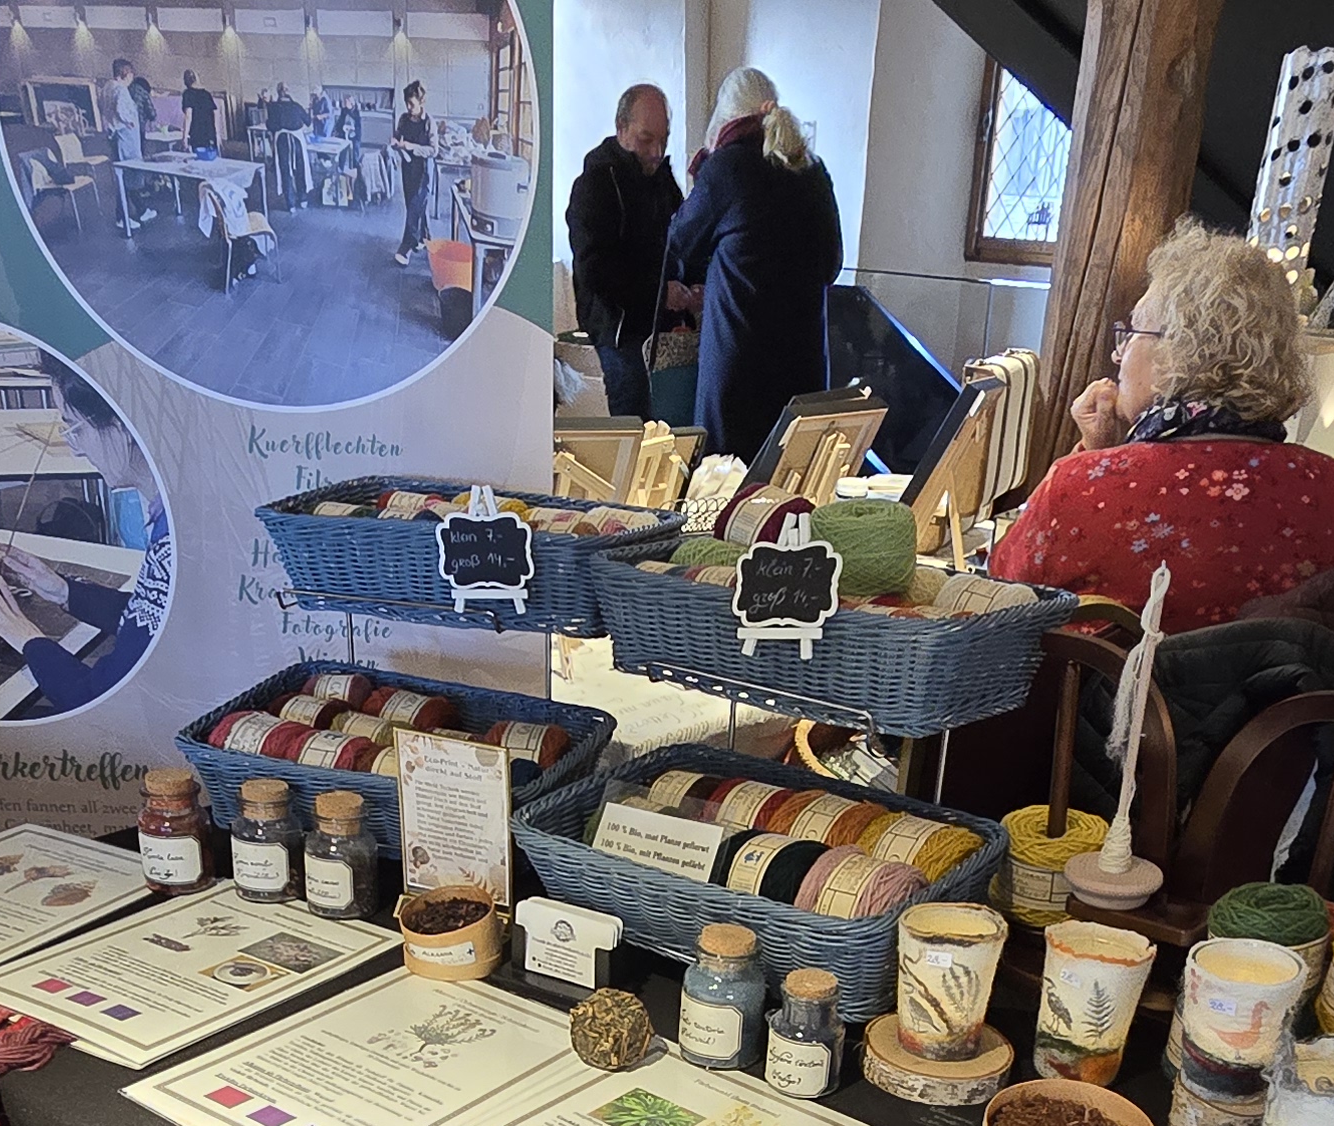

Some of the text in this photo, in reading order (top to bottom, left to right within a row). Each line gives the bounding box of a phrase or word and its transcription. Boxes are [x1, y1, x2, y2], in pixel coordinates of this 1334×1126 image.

[247, 425, 404, 460] Kuerfflechten
[282, 611, 392, 643] Fotografie
[26, 798, 77, 814] fannen
[80, 800, 97, 814] all
[628, 827, 644, 838] Bio,
[622, 843, 638, 855] Bio,
